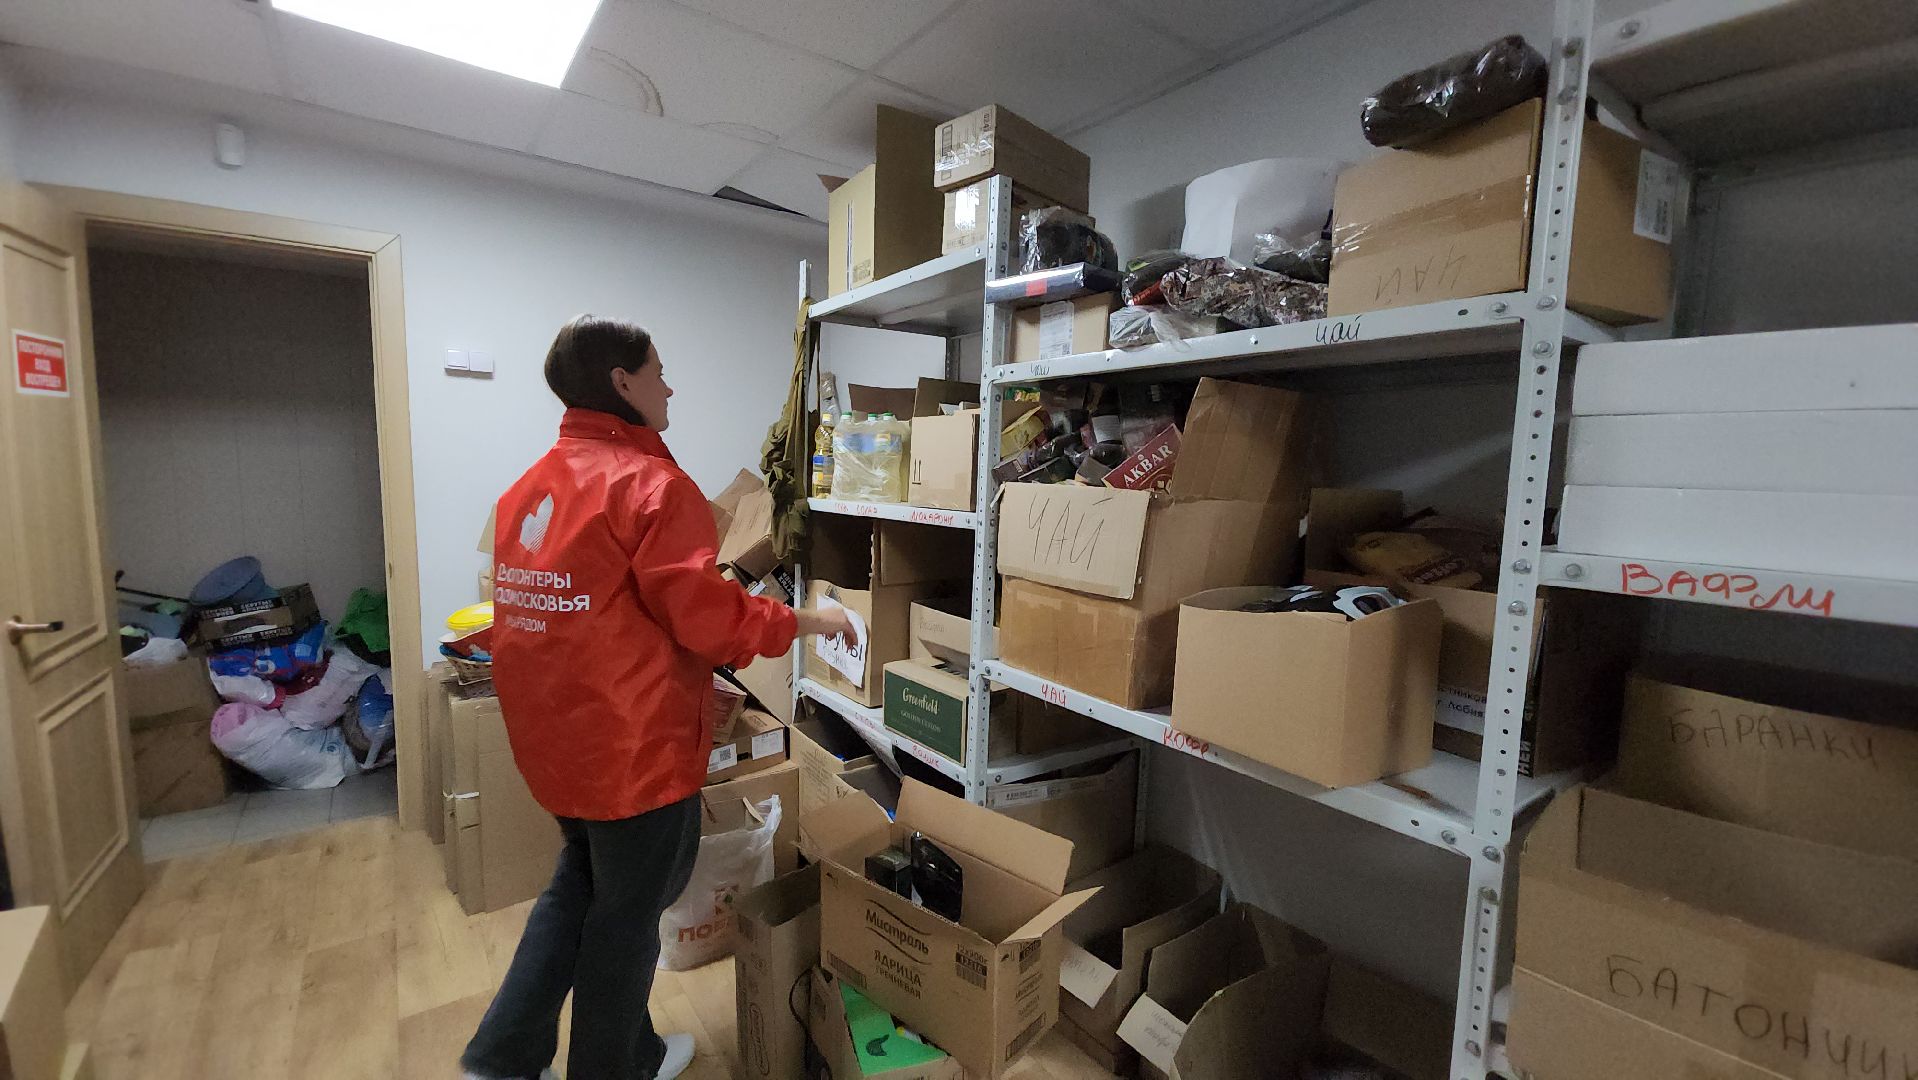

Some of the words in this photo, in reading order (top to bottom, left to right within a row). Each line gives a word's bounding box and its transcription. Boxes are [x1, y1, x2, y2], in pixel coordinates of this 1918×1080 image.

[1122, 441, 1174, 487] AKBAR
[495, 586, 591, 612] ОДМОСКОВЬЯ
[902, 687, 938, 715] Greenfield
[1668, 707, 1880, 771] БАРАНКИ
[865, 907, 929, 956] Мистраль
[873, 949, 922, 988] ЯДРИЦА
[1605, 954, 1918, 1080] БАТОНЧИ
